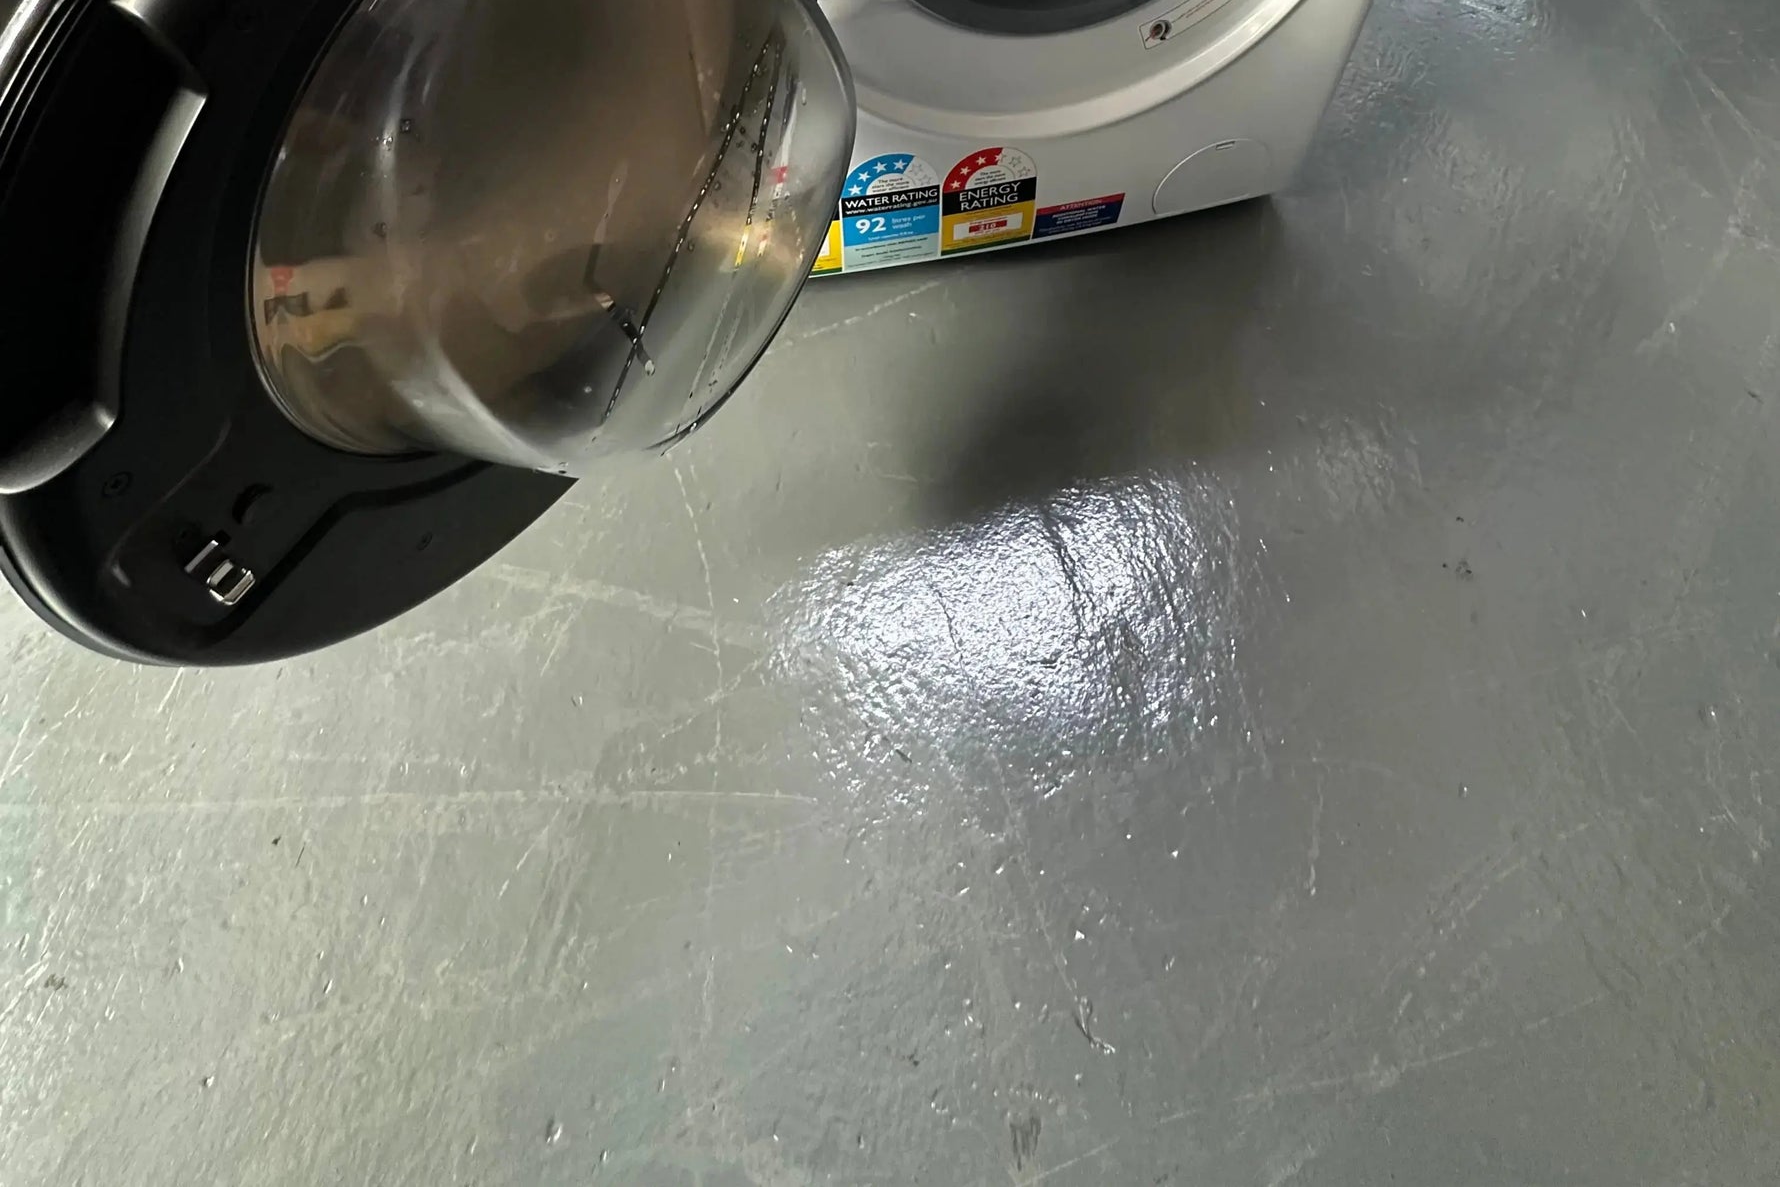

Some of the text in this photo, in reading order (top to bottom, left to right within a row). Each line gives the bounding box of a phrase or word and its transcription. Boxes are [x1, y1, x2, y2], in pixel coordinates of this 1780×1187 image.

[845, 188, 938, 209] WATER RATING
[960, 182, 1022, 202] ENERGY
[845, 198, 938, 215] www.waterrating.gov.au
[960, 193, 1018, 211] RATING
[855, 216, 887, 234] 92
